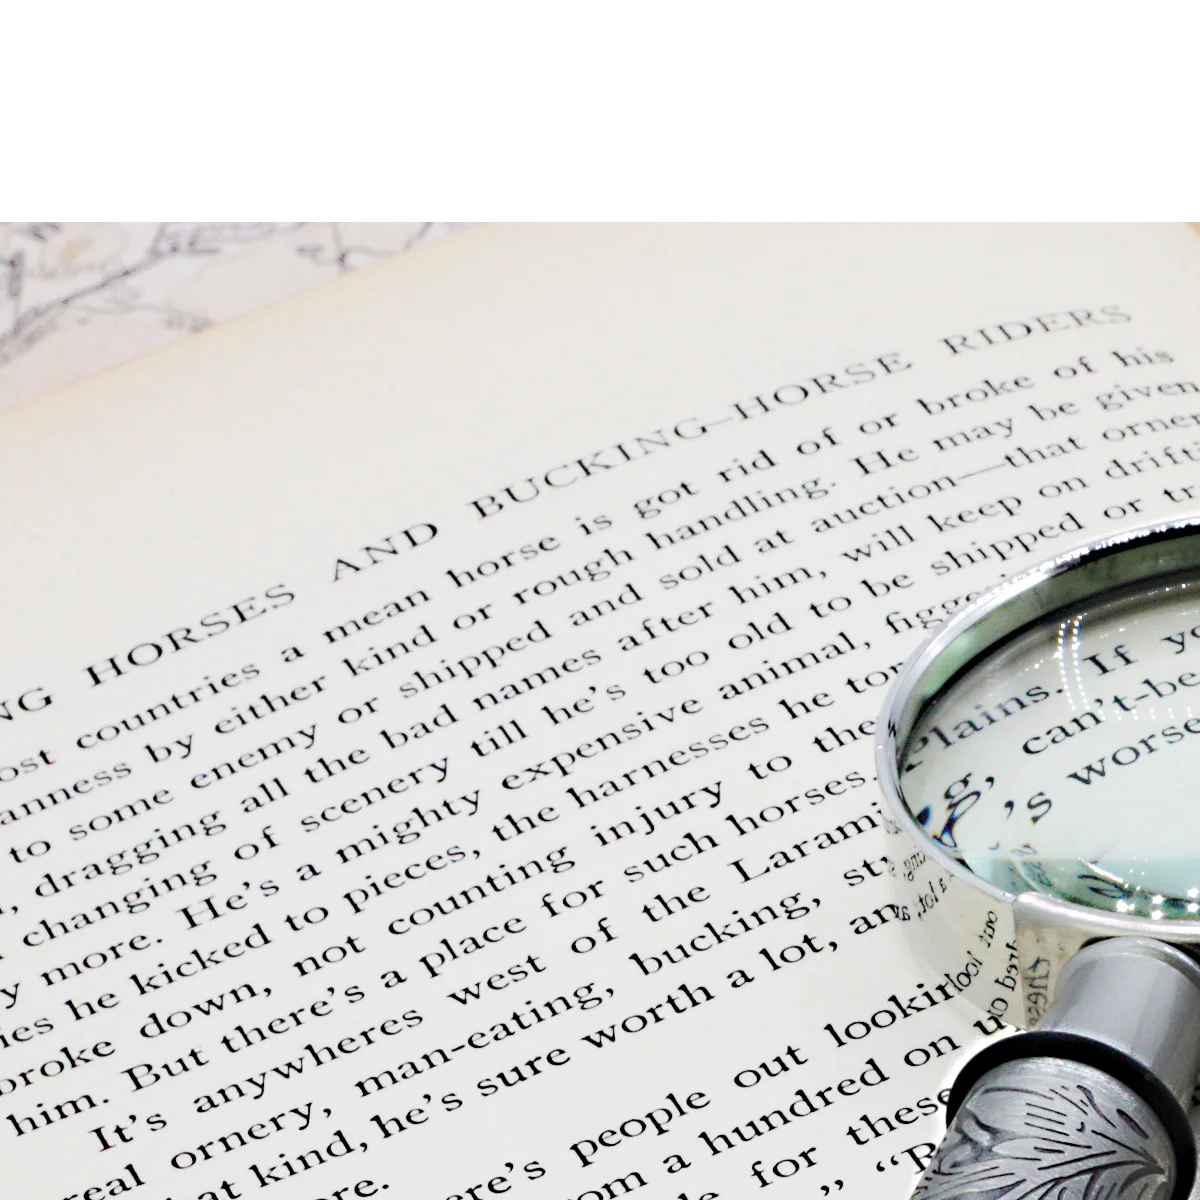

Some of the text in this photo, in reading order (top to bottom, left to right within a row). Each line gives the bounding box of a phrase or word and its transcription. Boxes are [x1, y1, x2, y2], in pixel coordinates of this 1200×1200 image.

[76, 351, 1174, 749] countries mean horse got rid broke his
[85, 584, 295, 686] HORSES
[334, 523, 438, 582] AND
[939, 303, 1133, 357] RIDERS
[144, 383, 1200, 763] by either kind rough handling. He may given
[23, 861, 217, 946] changing
[301, 757, 448, 832] scenery
[471, 720, 528, 757] till
[643, 652, 709, 684] too
[728, 612, 793, 649] old
[931, 512, 1085, 575] shipped
[35, 811, 227, 897] dragging
[241, 778, 289, 813] all
[379, 704, 458, 749] bad
[472, 650, 601, 711] names
[618, 602, 712, 651] after
[728, 568, 826, 604] him,
[842, 525, 915, 562] will
[927, 497, 1022, 532] keep
[69, 790, 173, 840] some
[190, 724, 316, 788] enemy
[400, 620, 552, 698] shipped
[659, 545, 741, 589] sold
[1083, 645, 1134, 675] If
[40, 632, 870, 986] more. mighty expensive animal,
[120, 1049, 209, 1092] But
[419, 918, 526, 978] place
[624, 832, 720, 883] such
[725, 772, 877, 836] horses.
[129, 718, 769, 995] kicked pieces, harnesses
[140, 781, 721, 1038] down, not counting injury
[171, 1102, 331, 1169] ornery,
[354, 983, 614, 1097] man-eating,
[628, 893, 820, 976] bucking,
[194, 955, 546, 1113] anywheres west
[248, 934, 837, 1188] kind, sure worth lot,
[569, 1092, 711, 1168] people
[698, 1058, 890, 1156] hundred
